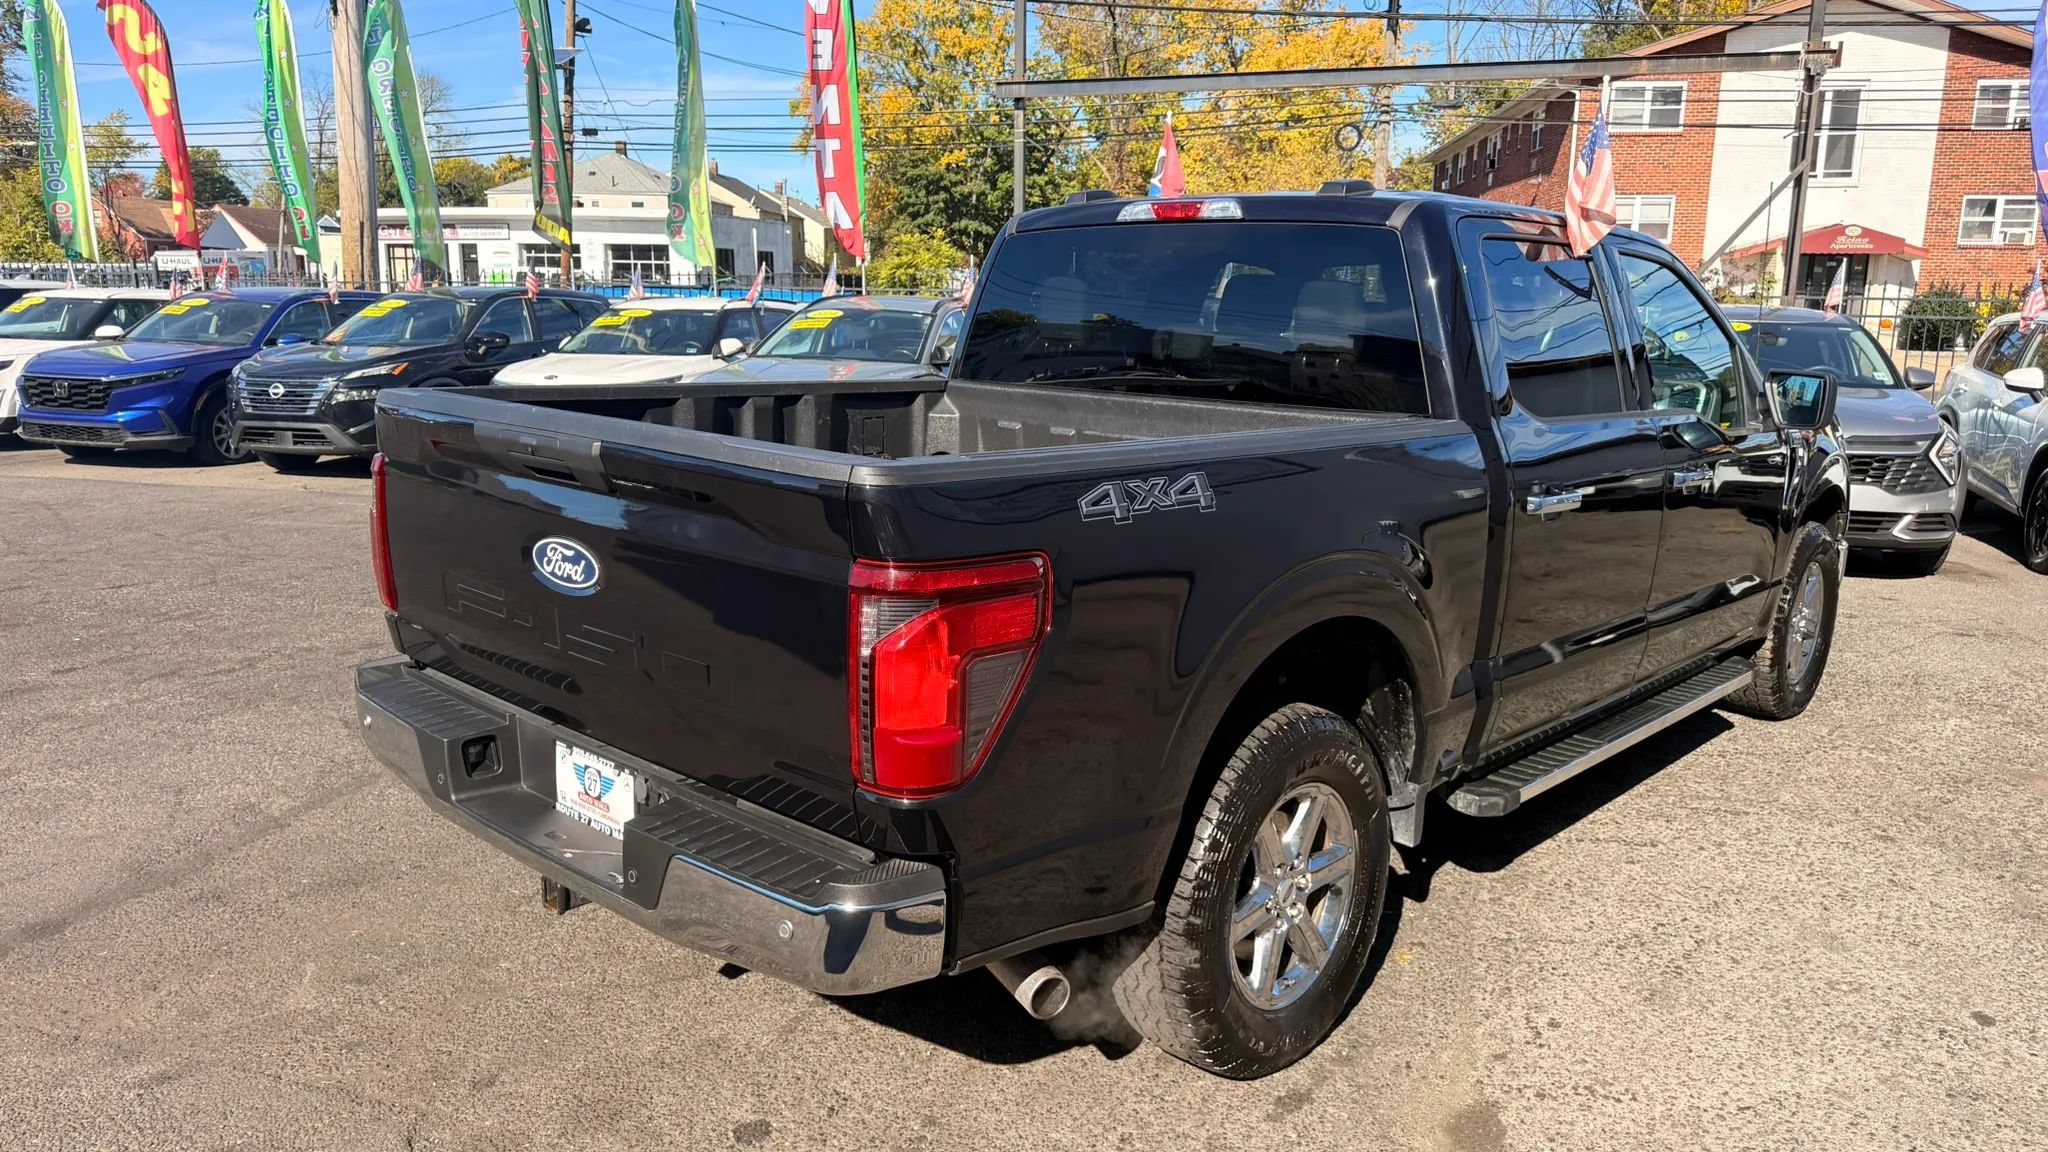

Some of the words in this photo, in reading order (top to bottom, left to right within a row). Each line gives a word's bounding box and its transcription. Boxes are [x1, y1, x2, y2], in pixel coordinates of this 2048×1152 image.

[1830, 242, 1874, 250] Apartments
[543, 543, 586, 583] Ford
[587, 776, 598, 793] 27
[556, 802, 580, 820] ROUTE
[580, 813, 589, 825] 27
[590, 817, 611, 835] AUTO
[612, 827, 624, 841] MA
